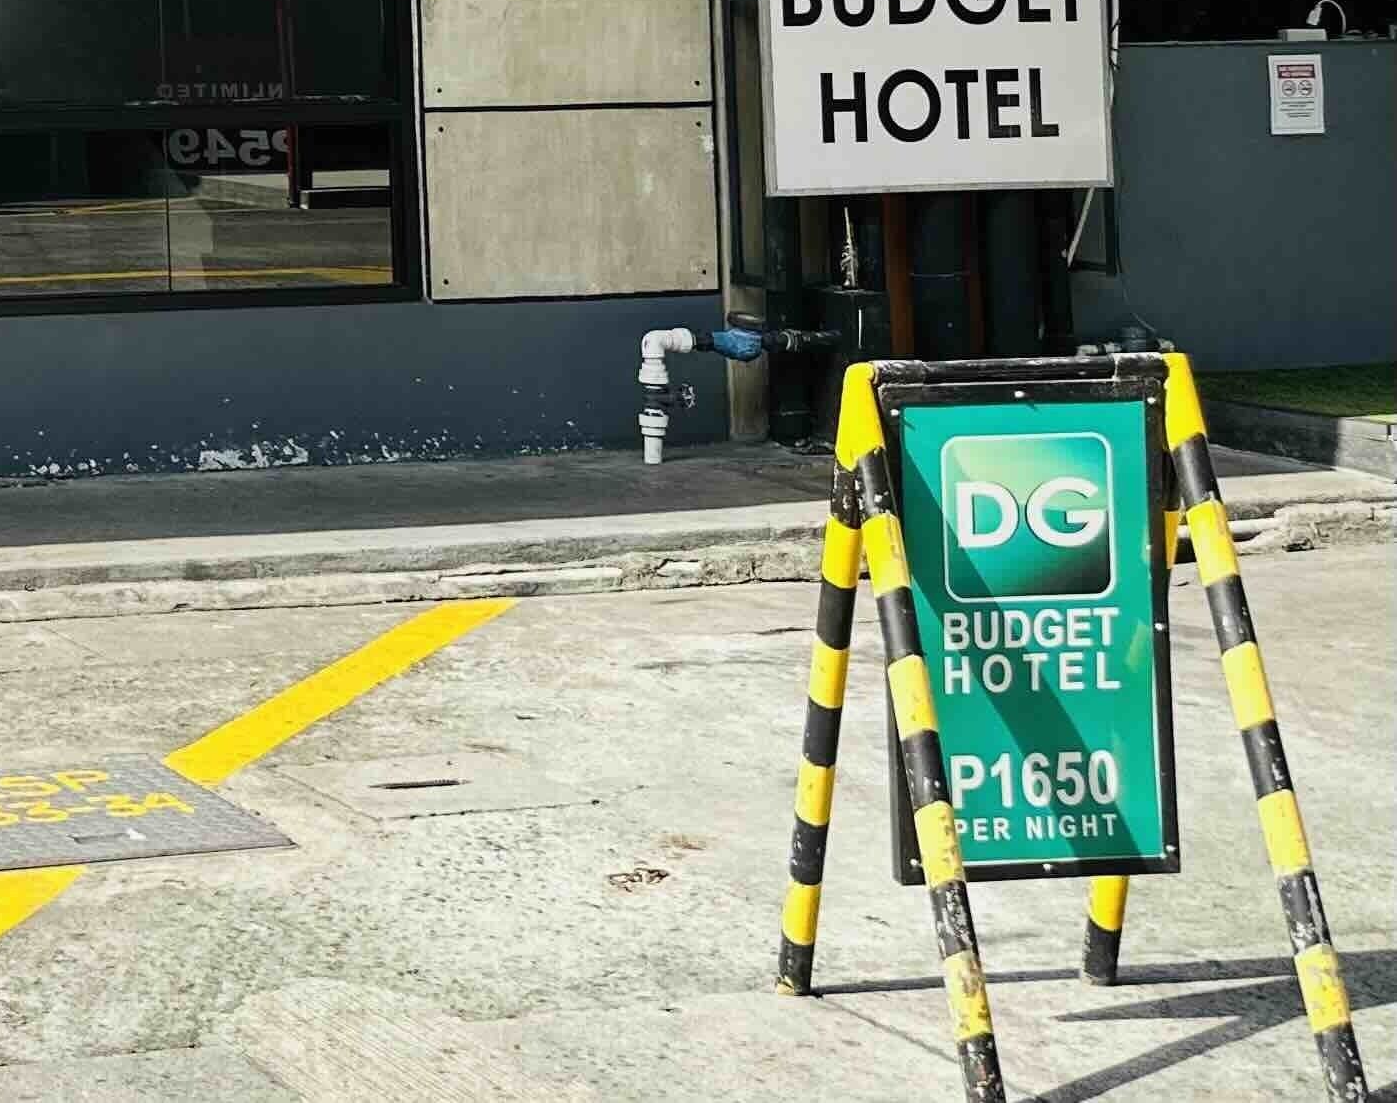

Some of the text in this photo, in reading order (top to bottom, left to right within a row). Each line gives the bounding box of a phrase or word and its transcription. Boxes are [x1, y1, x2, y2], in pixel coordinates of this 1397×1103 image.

[820, 68, 1059, 143] HOTEL
[955, 476, 1107, 547] DG
[943, 607, 1119, 651] BUDGET
[944, 652, 1121, 694] HOTEL
[950, 750, 1118, 810] P1650
[954, 814, 1117, 841] PER NIGHT
